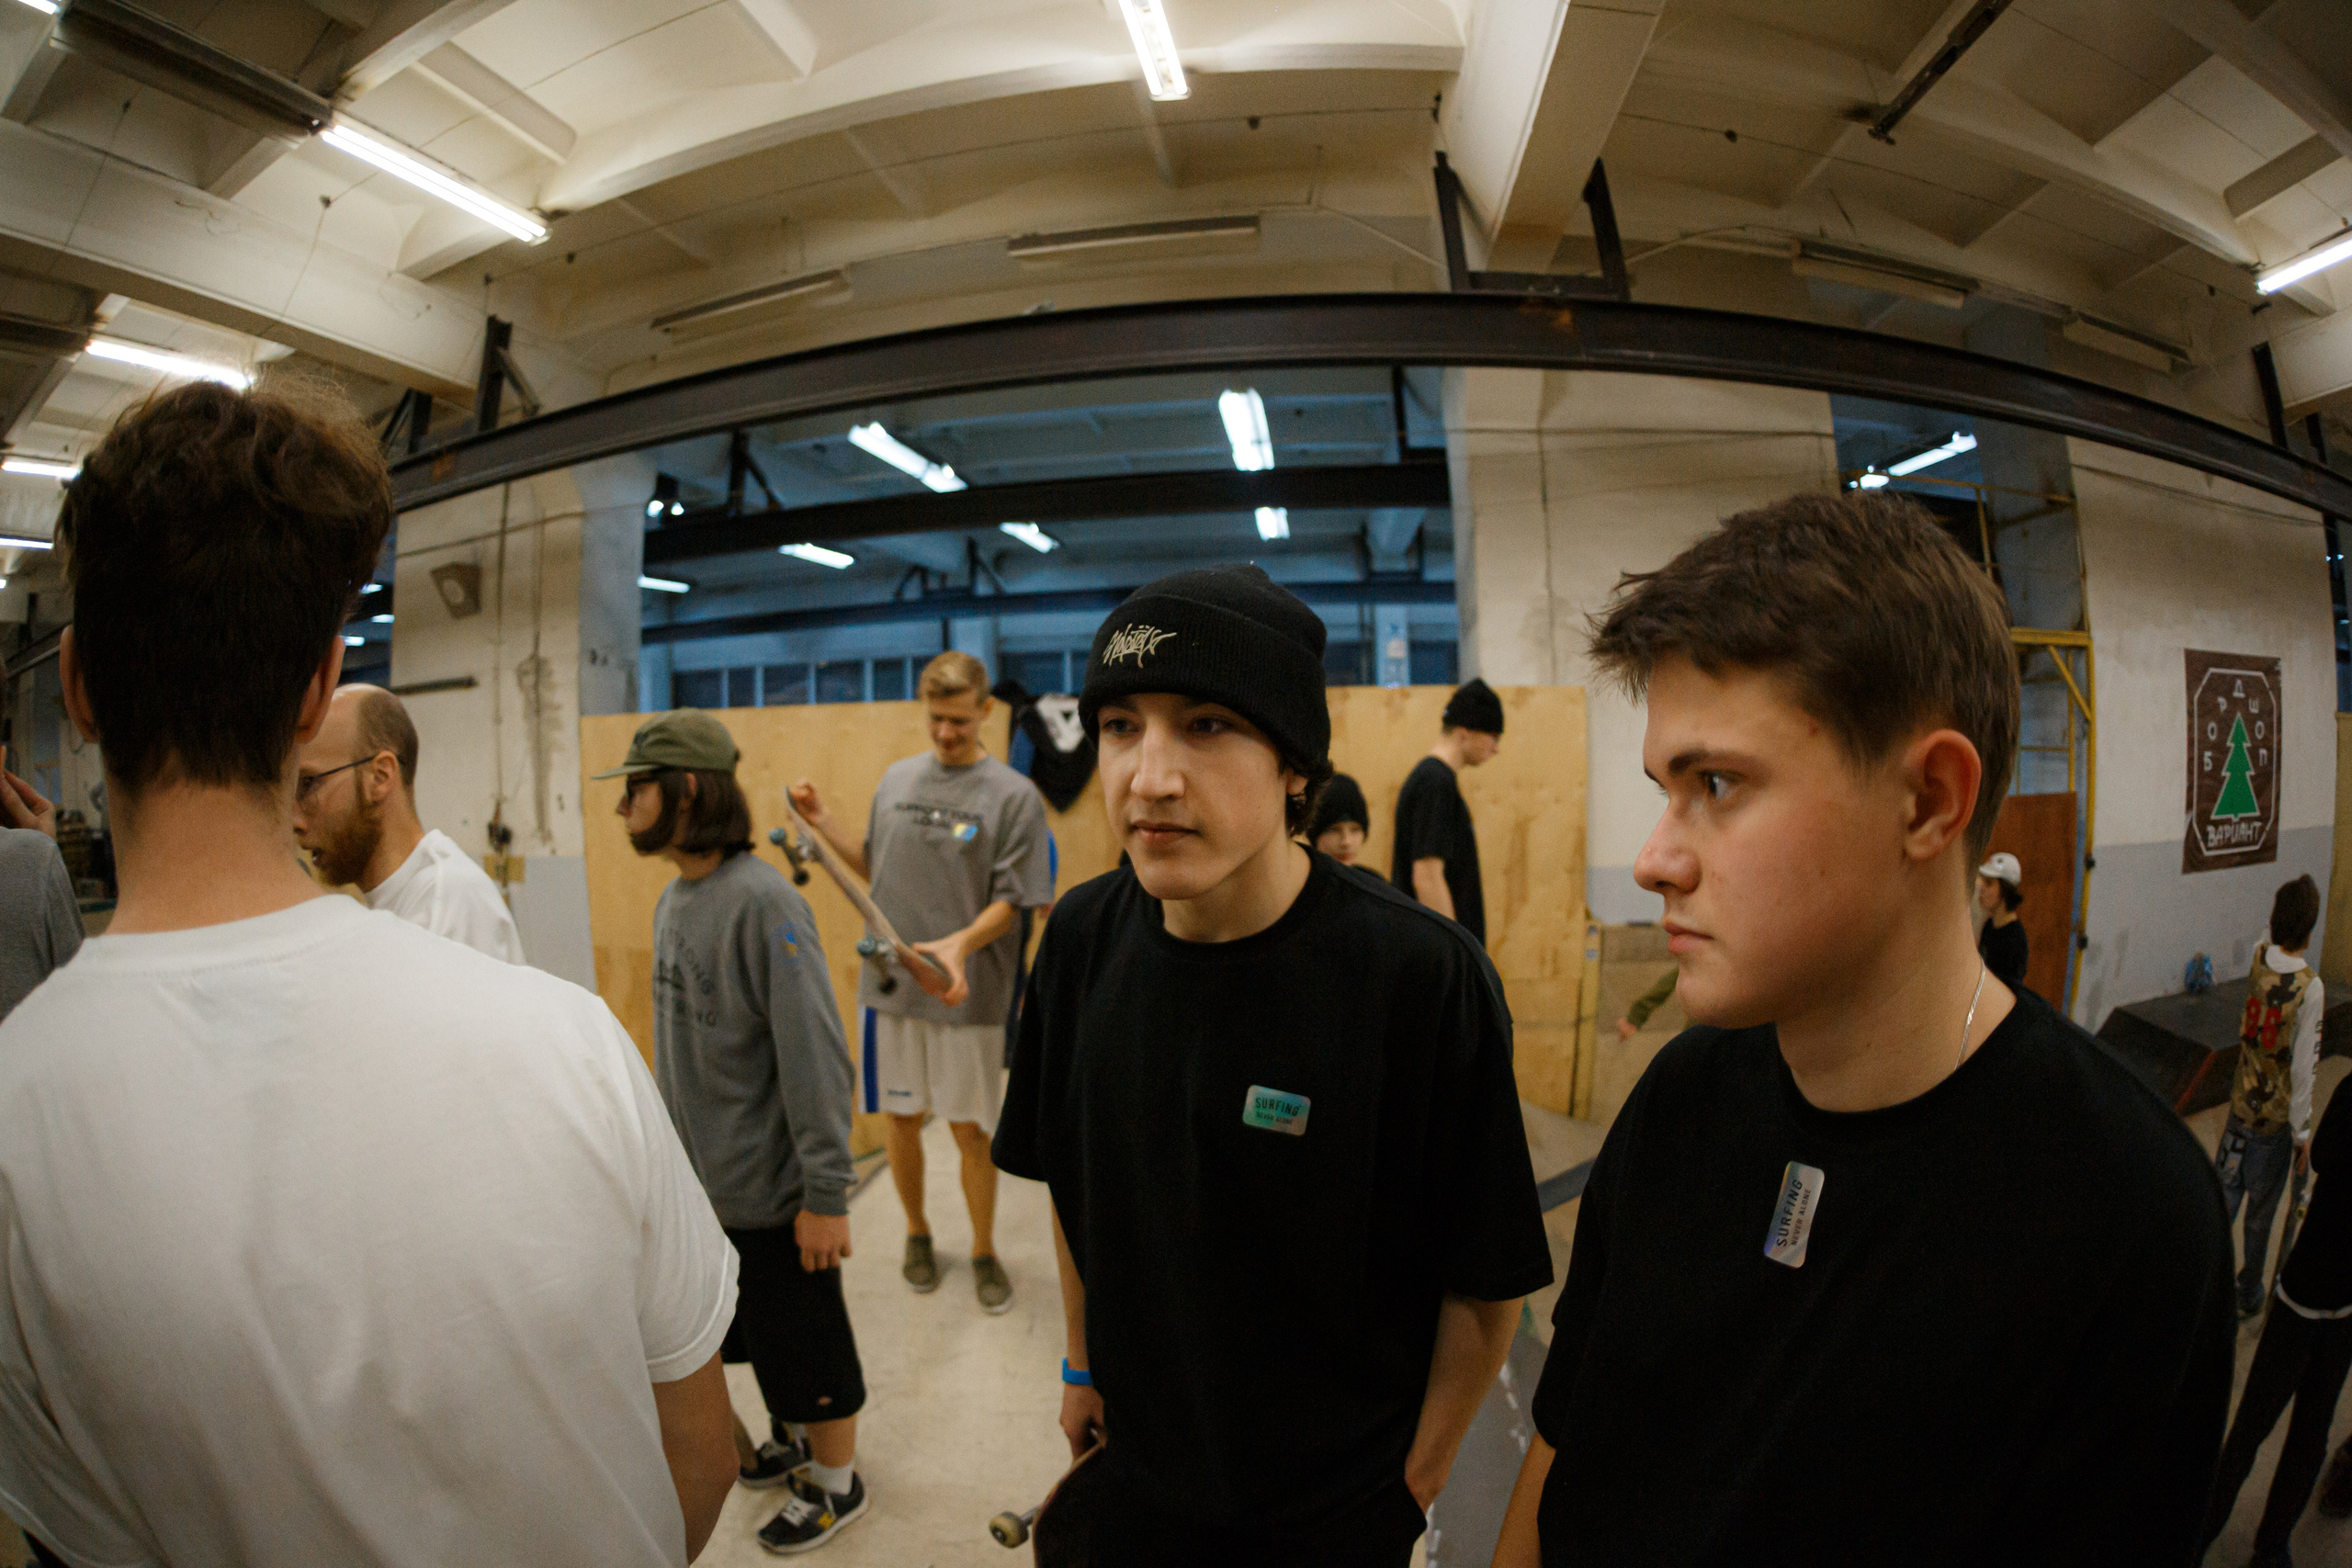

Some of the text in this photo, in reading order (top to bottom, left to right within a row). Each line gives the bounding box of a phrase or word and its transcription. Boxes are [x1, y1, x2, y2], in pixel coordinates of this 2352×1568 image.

[2245, 996, 2281, 1050] 96
[1255, 1097, 1300, 1117] SURFING
[1776, 1179, 1804, 1247] SURFING
[1791, 1188, 1811, 1247] NEVER ALONE
